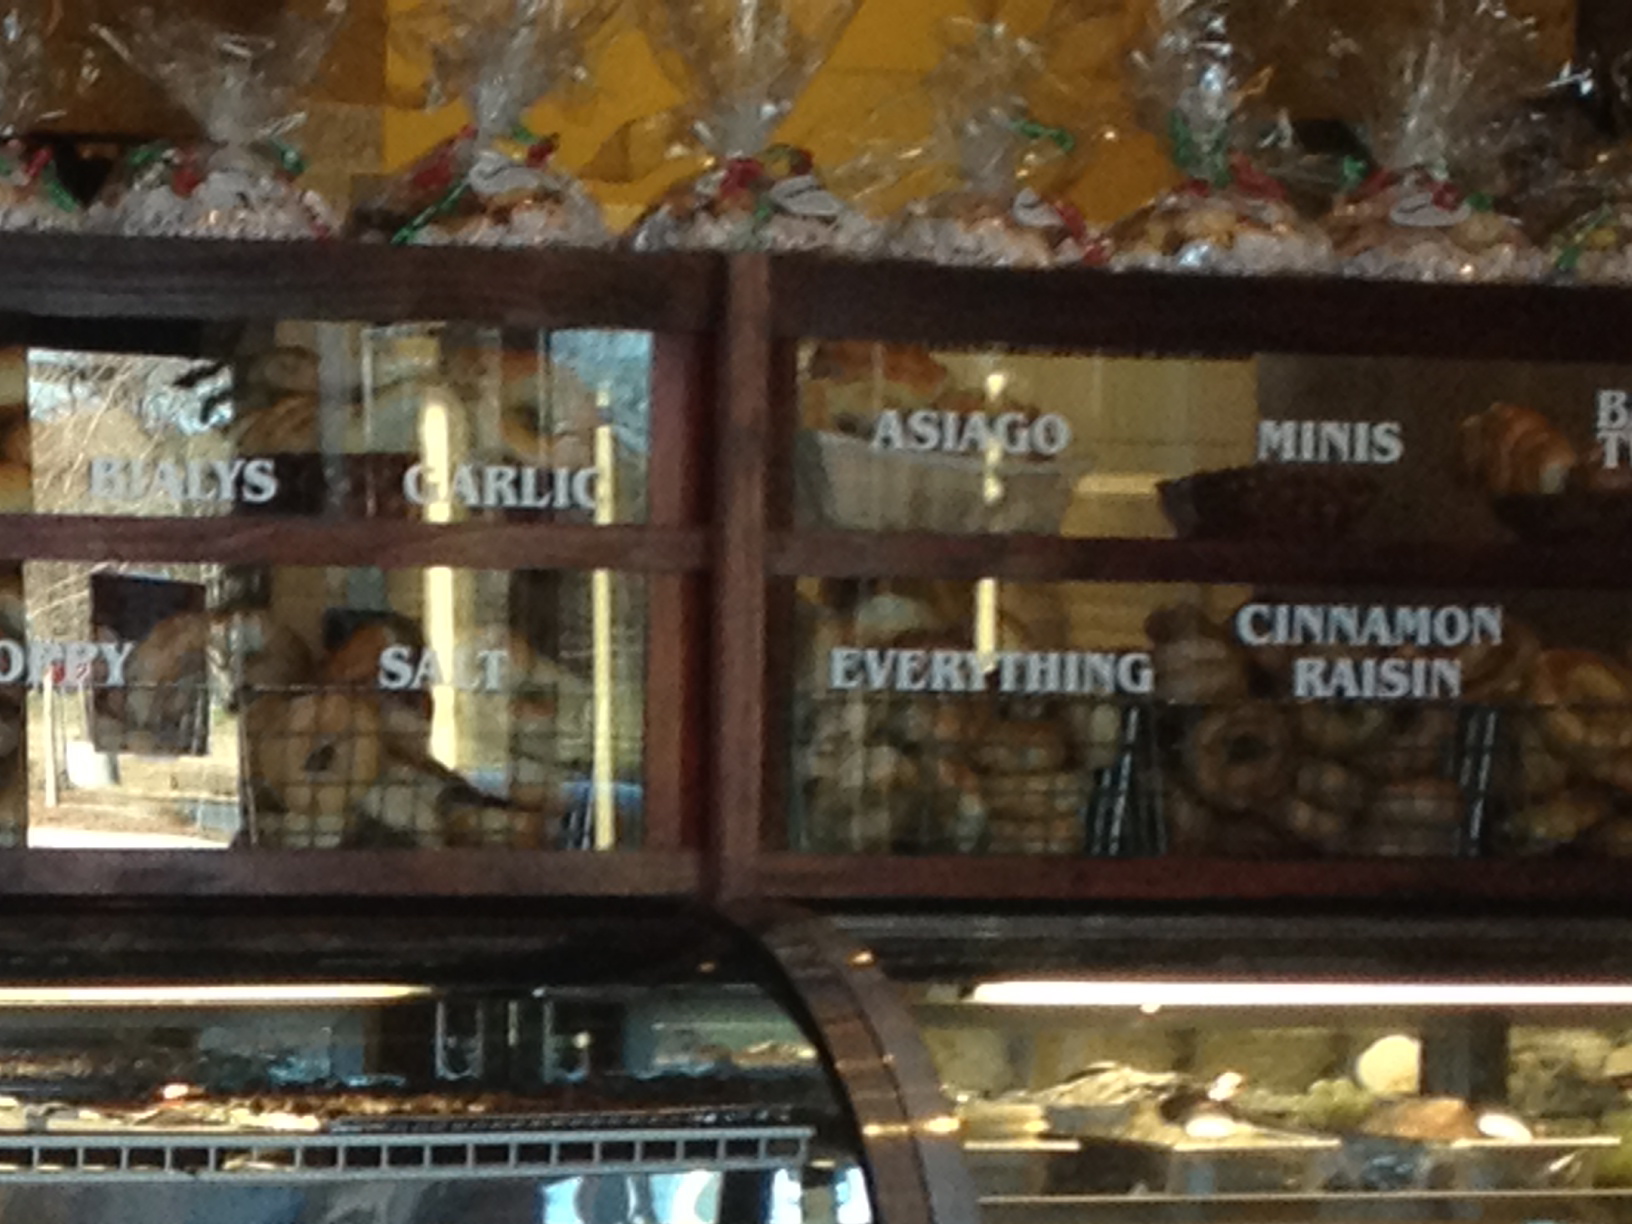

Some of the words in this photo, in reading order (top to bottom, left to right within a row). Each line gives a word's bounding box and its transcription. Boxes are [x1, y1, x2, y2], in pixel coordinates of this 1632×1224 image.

[871, 409, 1072, 456] ASIAGO
[1255, 420, 1405, 465] MINIS
[89, 457, 279, 504] BIALYS
[402, 462, 611, 510] GARLIC
[1235, 602, 1504, 648] CINNAMON
[378, 645, 509, 691] SALT
[829, 646, 1155, 697] EVERYTHING
[1292, 656, 1464, 701] RAISIN
